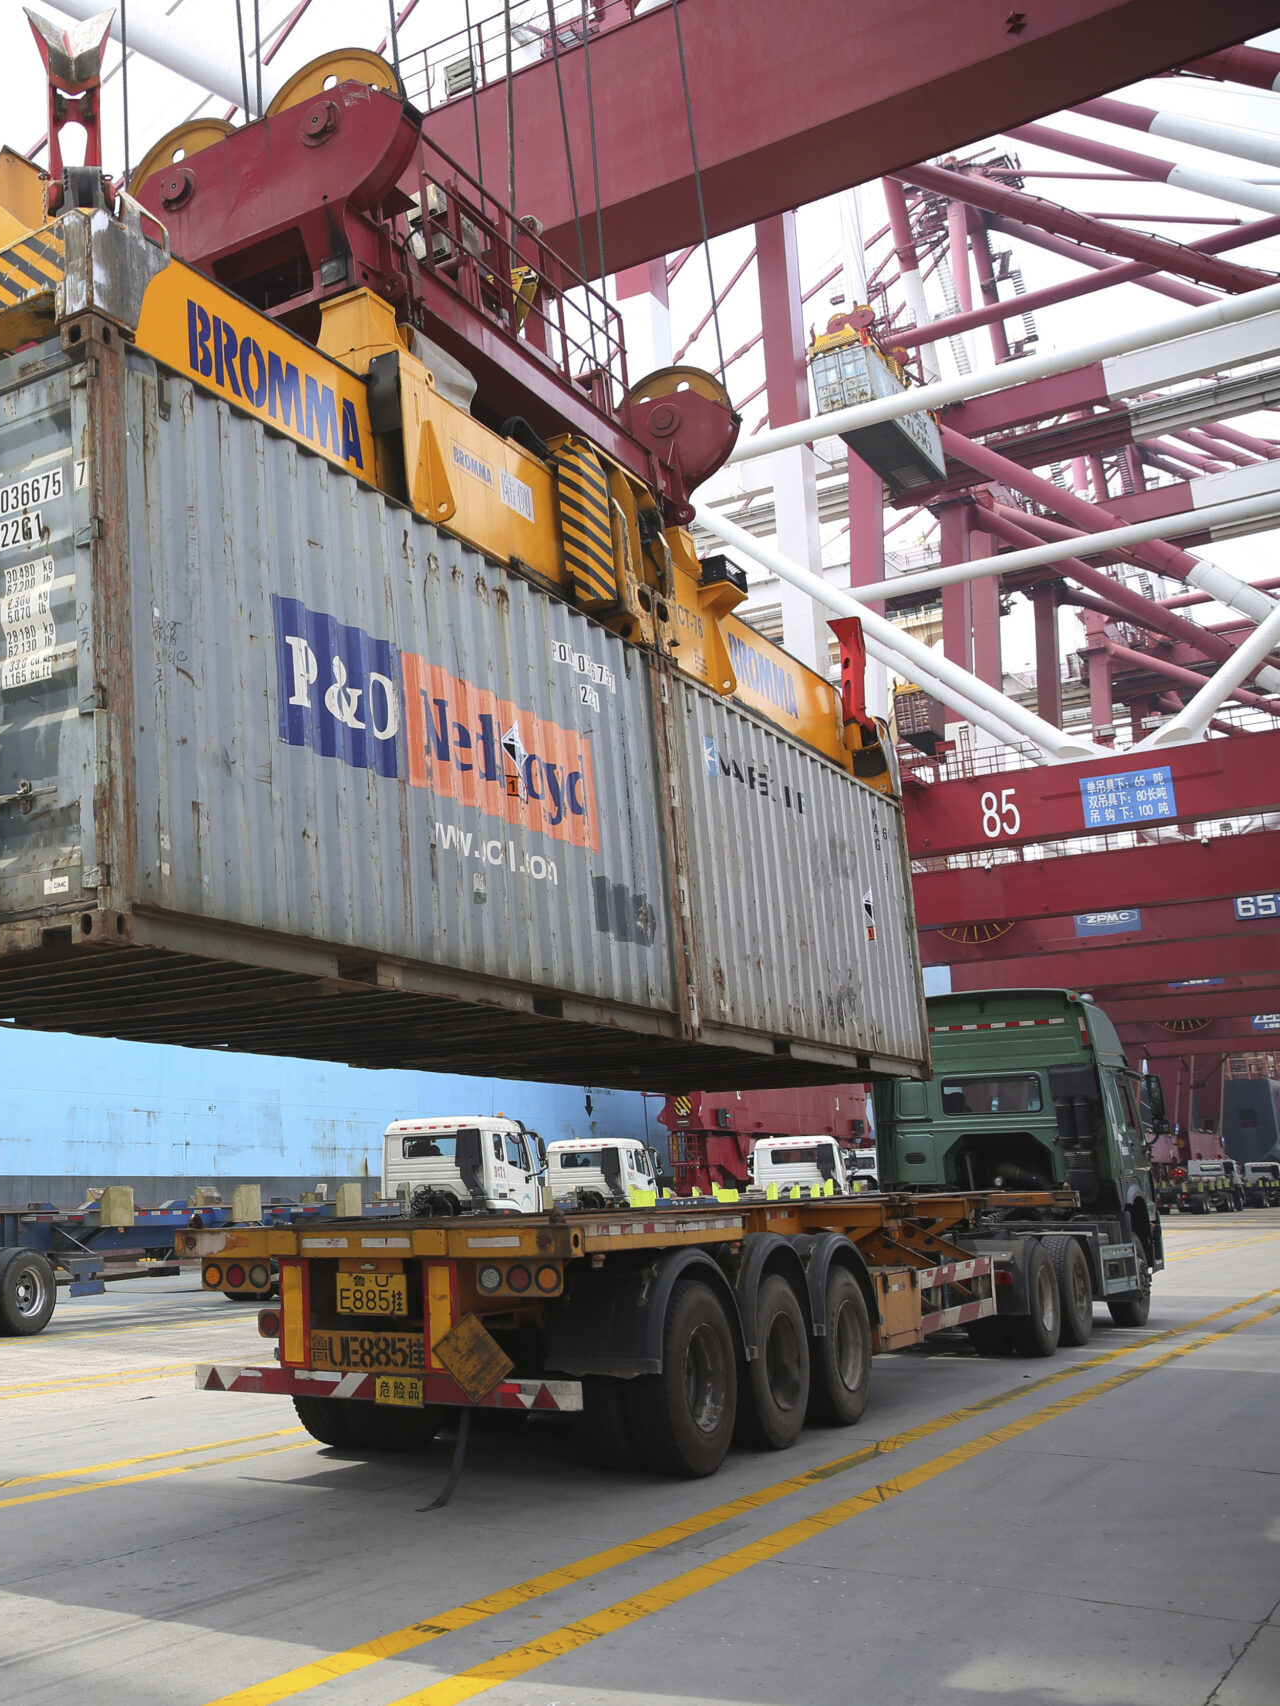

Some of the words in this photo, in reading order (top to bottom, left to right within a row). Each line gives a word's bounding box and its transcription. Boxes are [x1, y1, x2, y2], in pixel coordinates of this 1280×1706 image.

[187, 298, 364, 470] BROMMA
[453, 446, 493, 486] BROMMA
[0, 471, 61, 513] 036675
[76, 461, 86, 486] 7
[0, 513, 42, 548] 22G1
[6, 564, 35, 584] 30.480
[42, 560, 53, 573] kg
[7, 606, 31, 624] 5.070
[38, 602, 47, 615] lb
[6, 625, 36, 645] 28.180
[42, 622, 54, 635] kg
[8, 639, 37, 659] 62.130
[4, 673, 27, 688] 1.165
[727, 631, 799, 720] BROMMA
[285, 635, 399, 741] P&O
[980, 788, 1021, 838] 85
[1085, 911, 1131, 925] ZPMC
[339, 1288, 403, 1312] E885挂
[379, 1381, 420, 1400] 危险品
